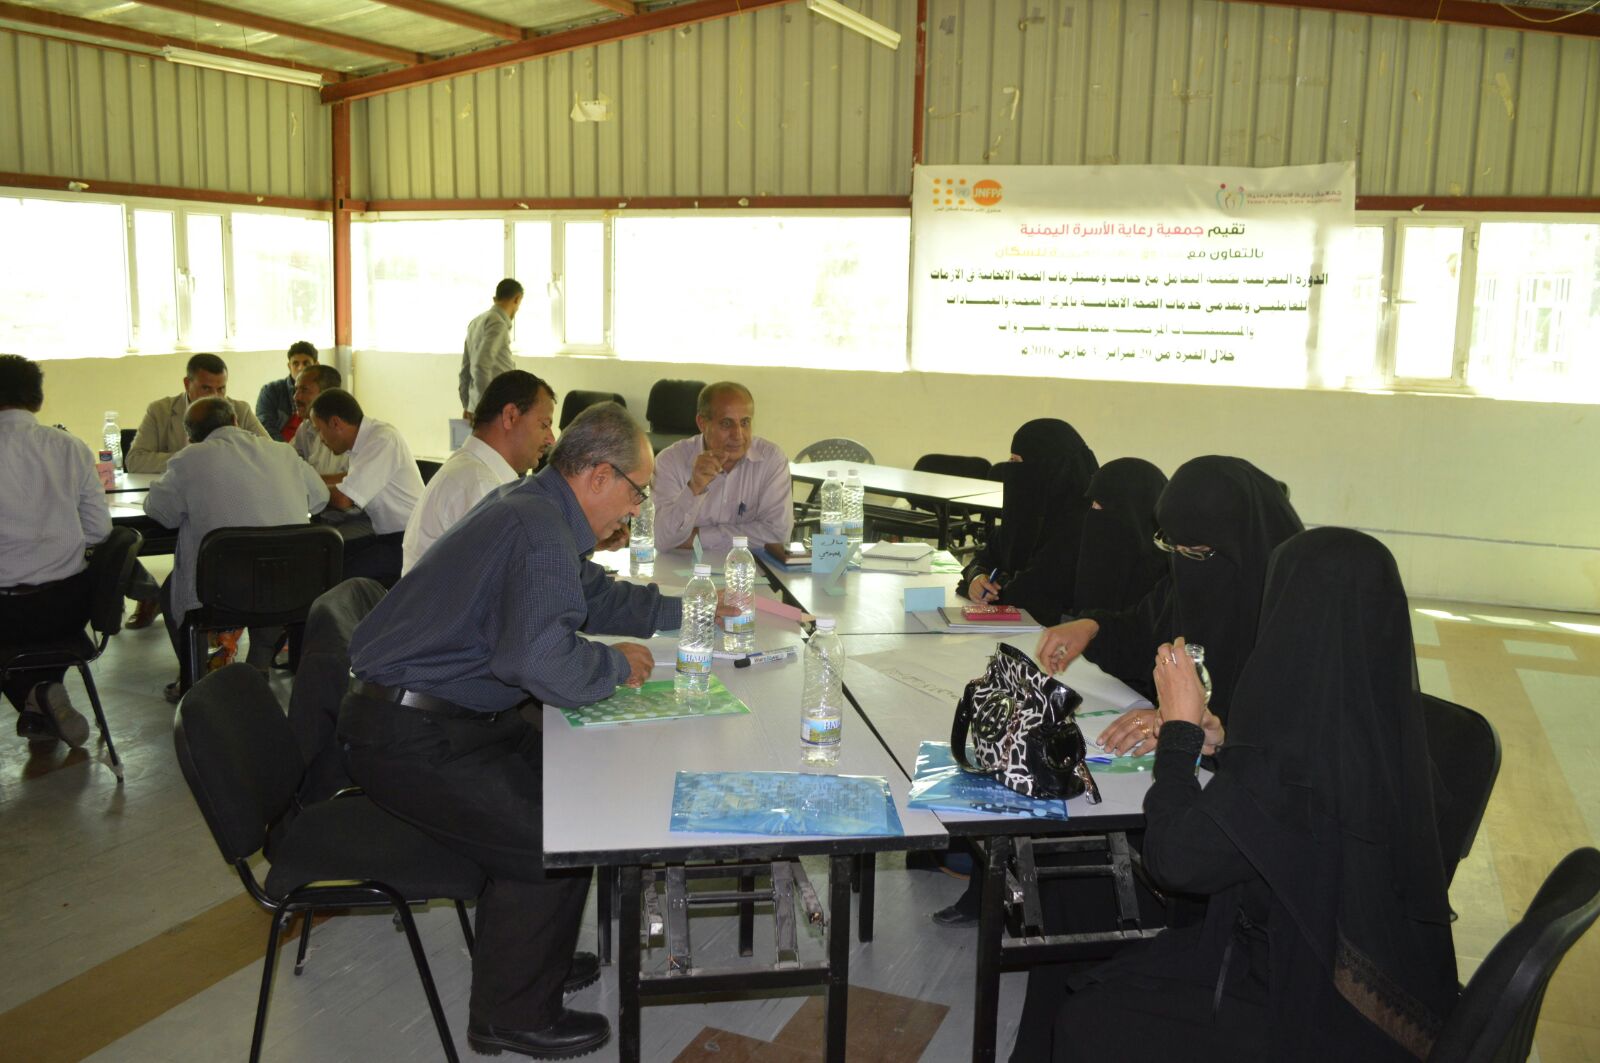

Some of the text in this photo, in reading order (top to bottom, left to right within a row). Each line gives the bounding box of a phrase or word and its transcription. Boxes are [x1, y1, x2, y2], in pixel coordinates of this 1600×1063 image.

[1020, 222, 1245, 238] تقيم جمعية رعاية الأسرة اليمنية
[1186, 250, 1206, 260] مع
[1209, 248, 1264, 261] بالتعاون
[1145, 275, 1159, 286] مع
